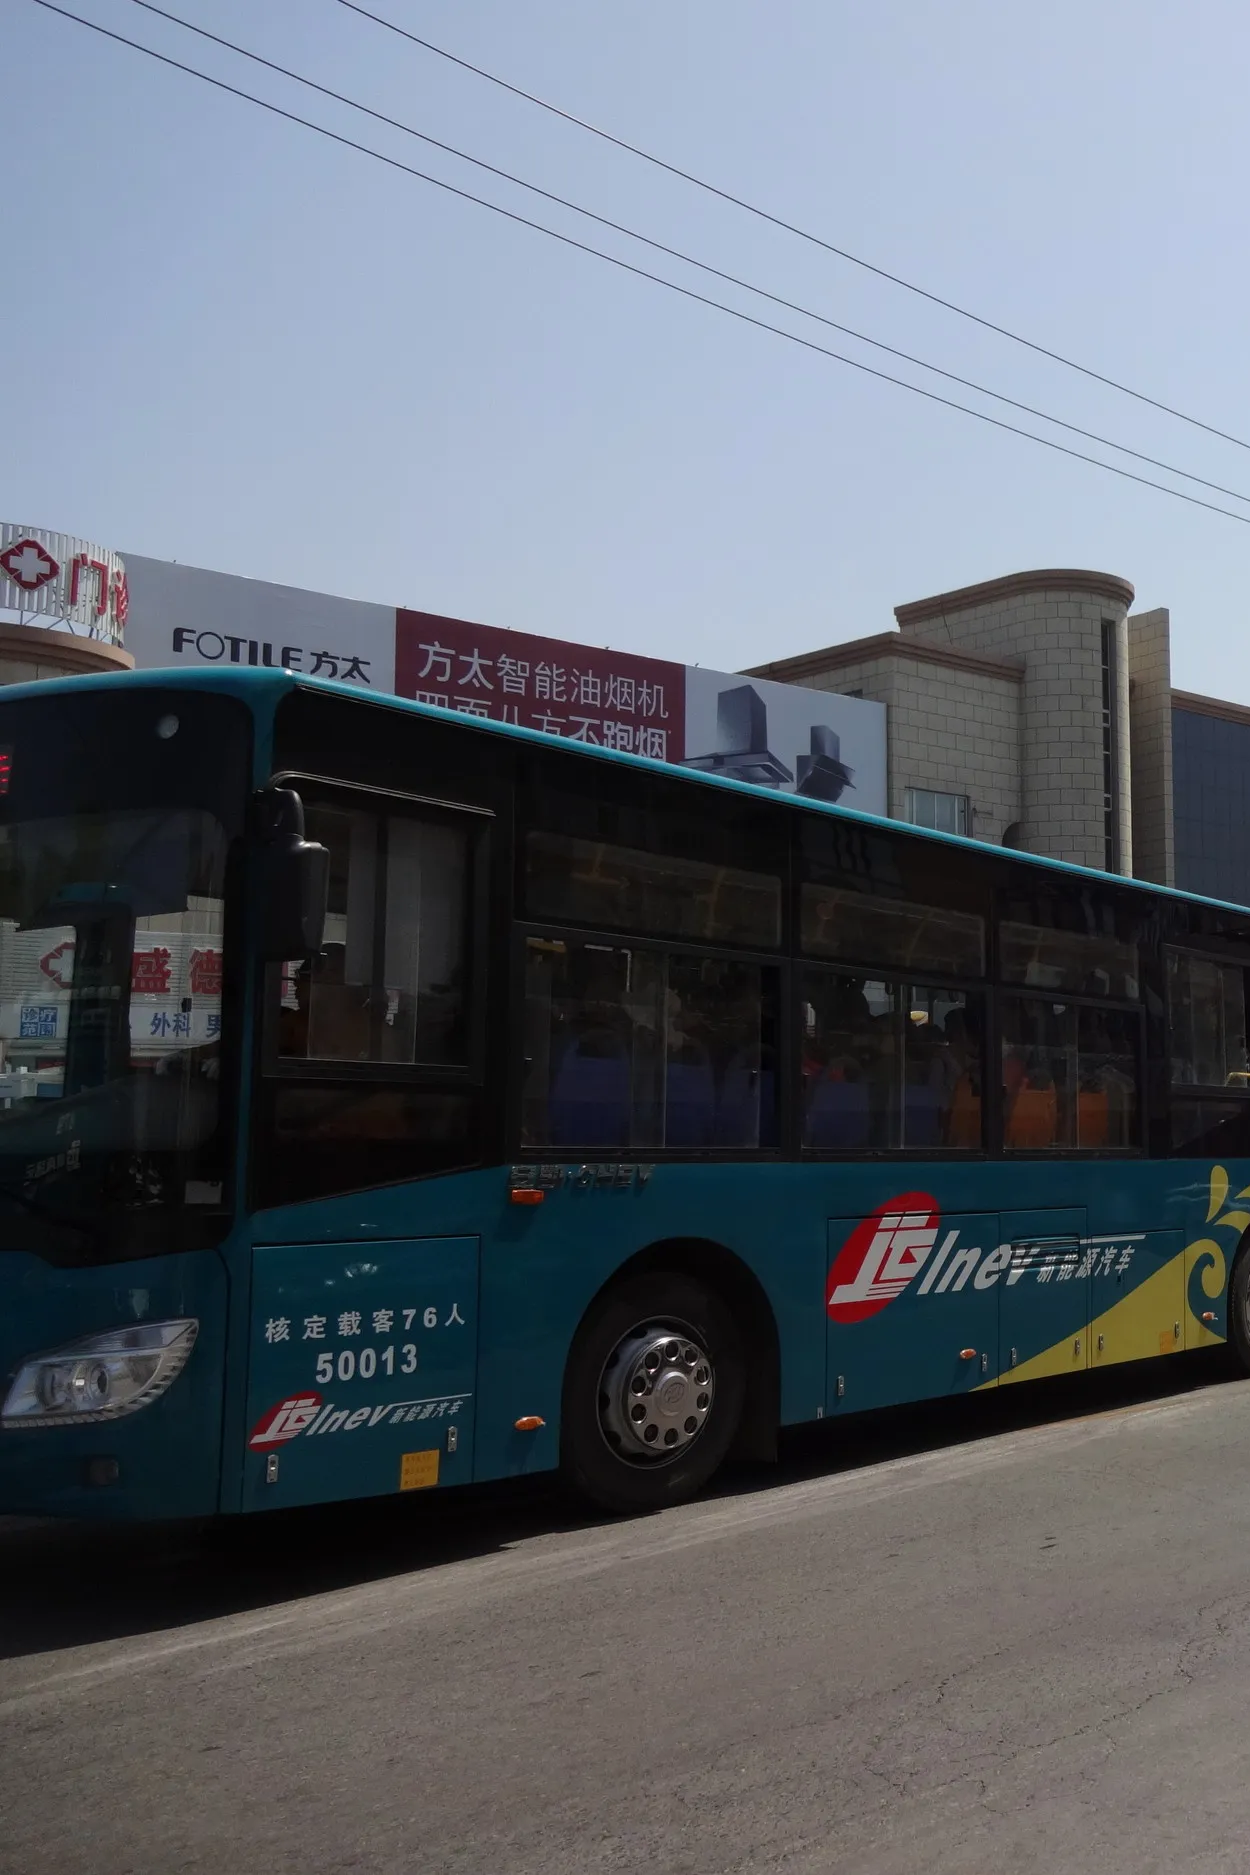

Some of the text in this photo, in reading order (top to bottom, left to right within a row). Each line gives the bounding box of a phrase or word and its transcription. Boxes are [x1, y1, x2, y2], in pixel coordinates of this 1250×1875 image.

[173, 627, 371, 684] FOTILE 方太
[417, 640, 669, 720] 方太智能油烟机
[315, 1343, 418, 1384] 50013
